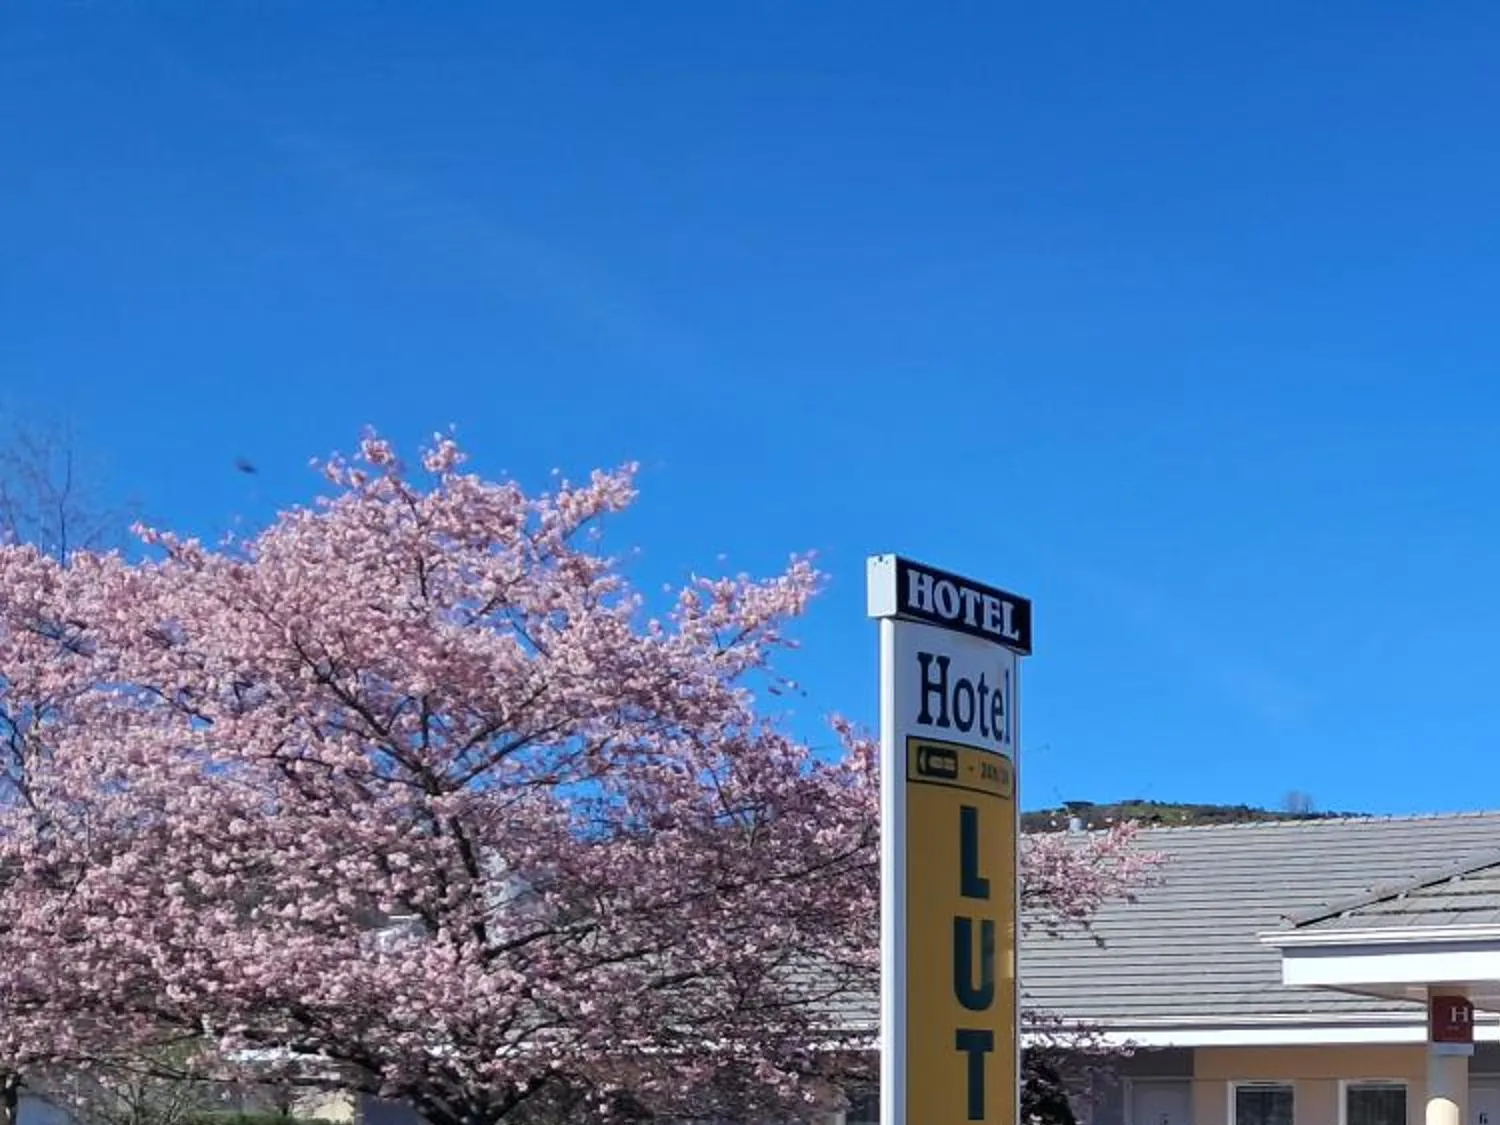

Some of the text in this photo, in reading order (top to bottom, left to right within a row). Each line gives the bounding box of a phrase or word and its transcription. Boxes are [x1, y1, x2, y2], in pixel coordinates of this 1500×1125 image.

[906, 568, 1020, 641] HOTEL
[916, 651, 1011, 744] Hotel
[1451, 1006, 1468, 1022] H
